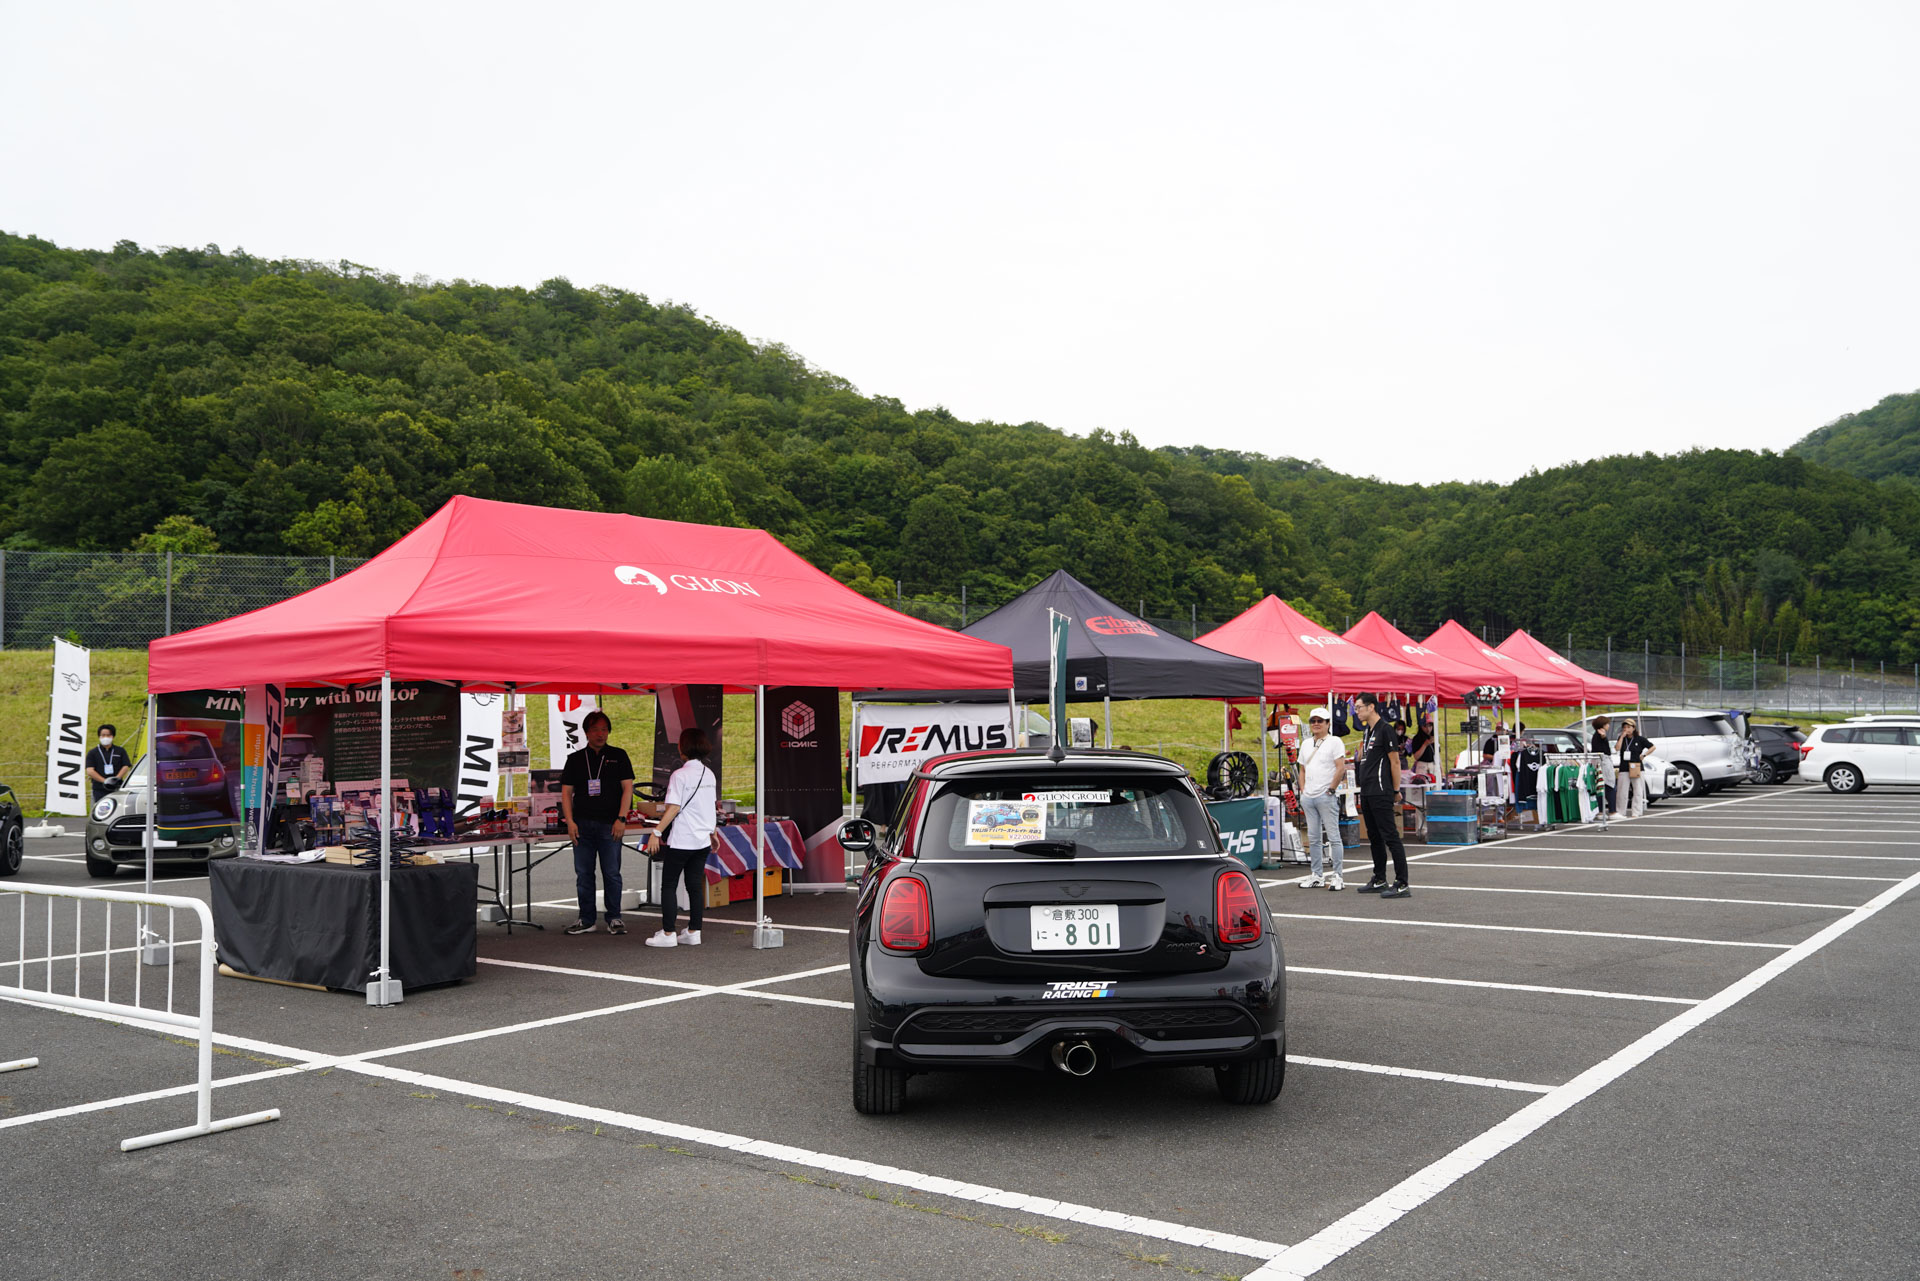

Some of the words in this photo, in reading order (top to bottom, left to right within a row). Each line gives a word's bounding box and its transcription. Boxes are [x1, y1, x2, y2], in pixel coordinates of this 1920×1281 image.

[670, 575, 760, 597] GLION
[315, 690, 351, 705] with
[355, 688, 419, 703] DULOP
[874, 724, 1007, 754] REMUS
[57, 713, 83, 799] MINI
[1037, 793, 1071, 801] GLION
[1072, 792, 1109, 801] GROUP
[1046, 981, 1118, 990] TRUST
[1042, 990, 1093, 999] RACING
